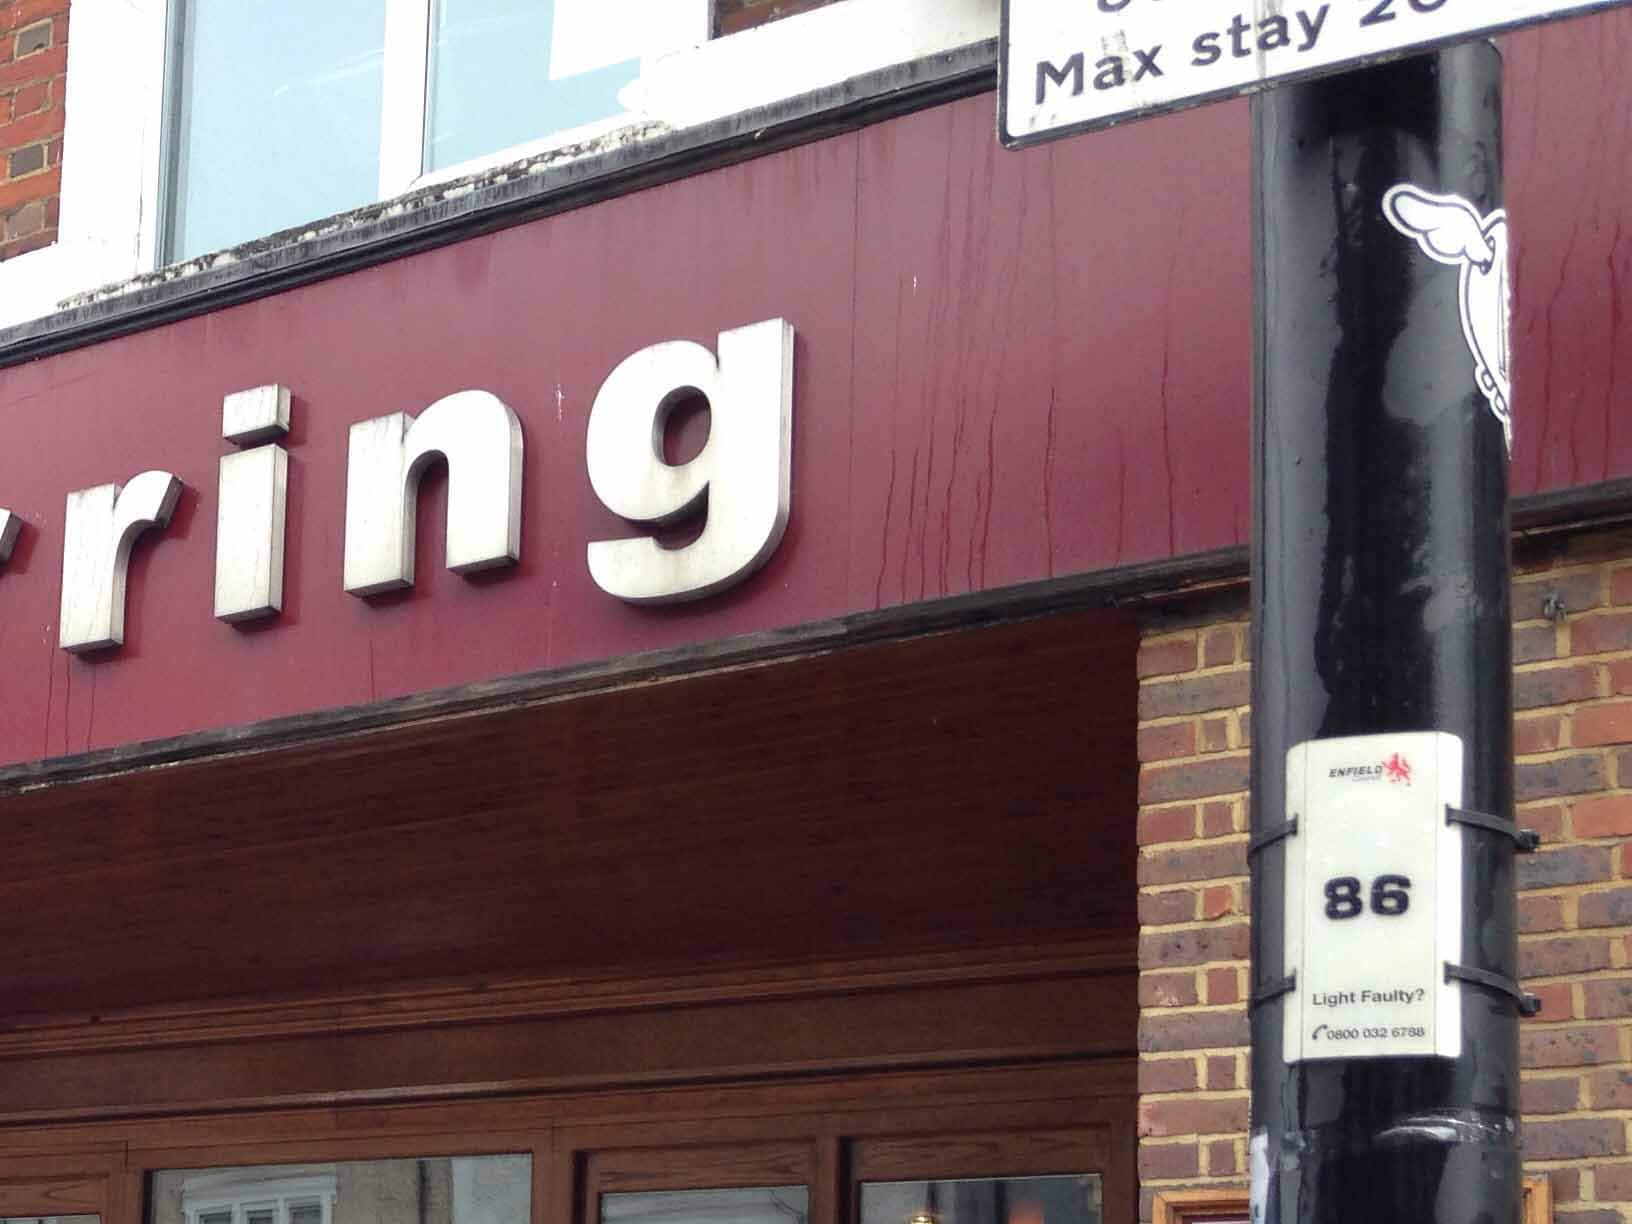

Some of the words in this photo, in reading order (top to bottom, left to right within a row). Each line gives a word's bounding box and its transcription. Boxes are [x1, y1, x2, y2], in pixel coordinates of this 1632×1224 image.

[1034, 43, 1164, 106] Max
[1190, 1, 1330, 67] stay
[1328, 764, 1383, 778] ENFIELD
[1323, 873, 1412, 921] 86
[1311, 991, 1356, 1008] Light
[1360, 987, 1425, 1005] Faulty?
[1326, 1027, 1359, 1041] 0800
[1362, 1026, 1388, 1039] 032
